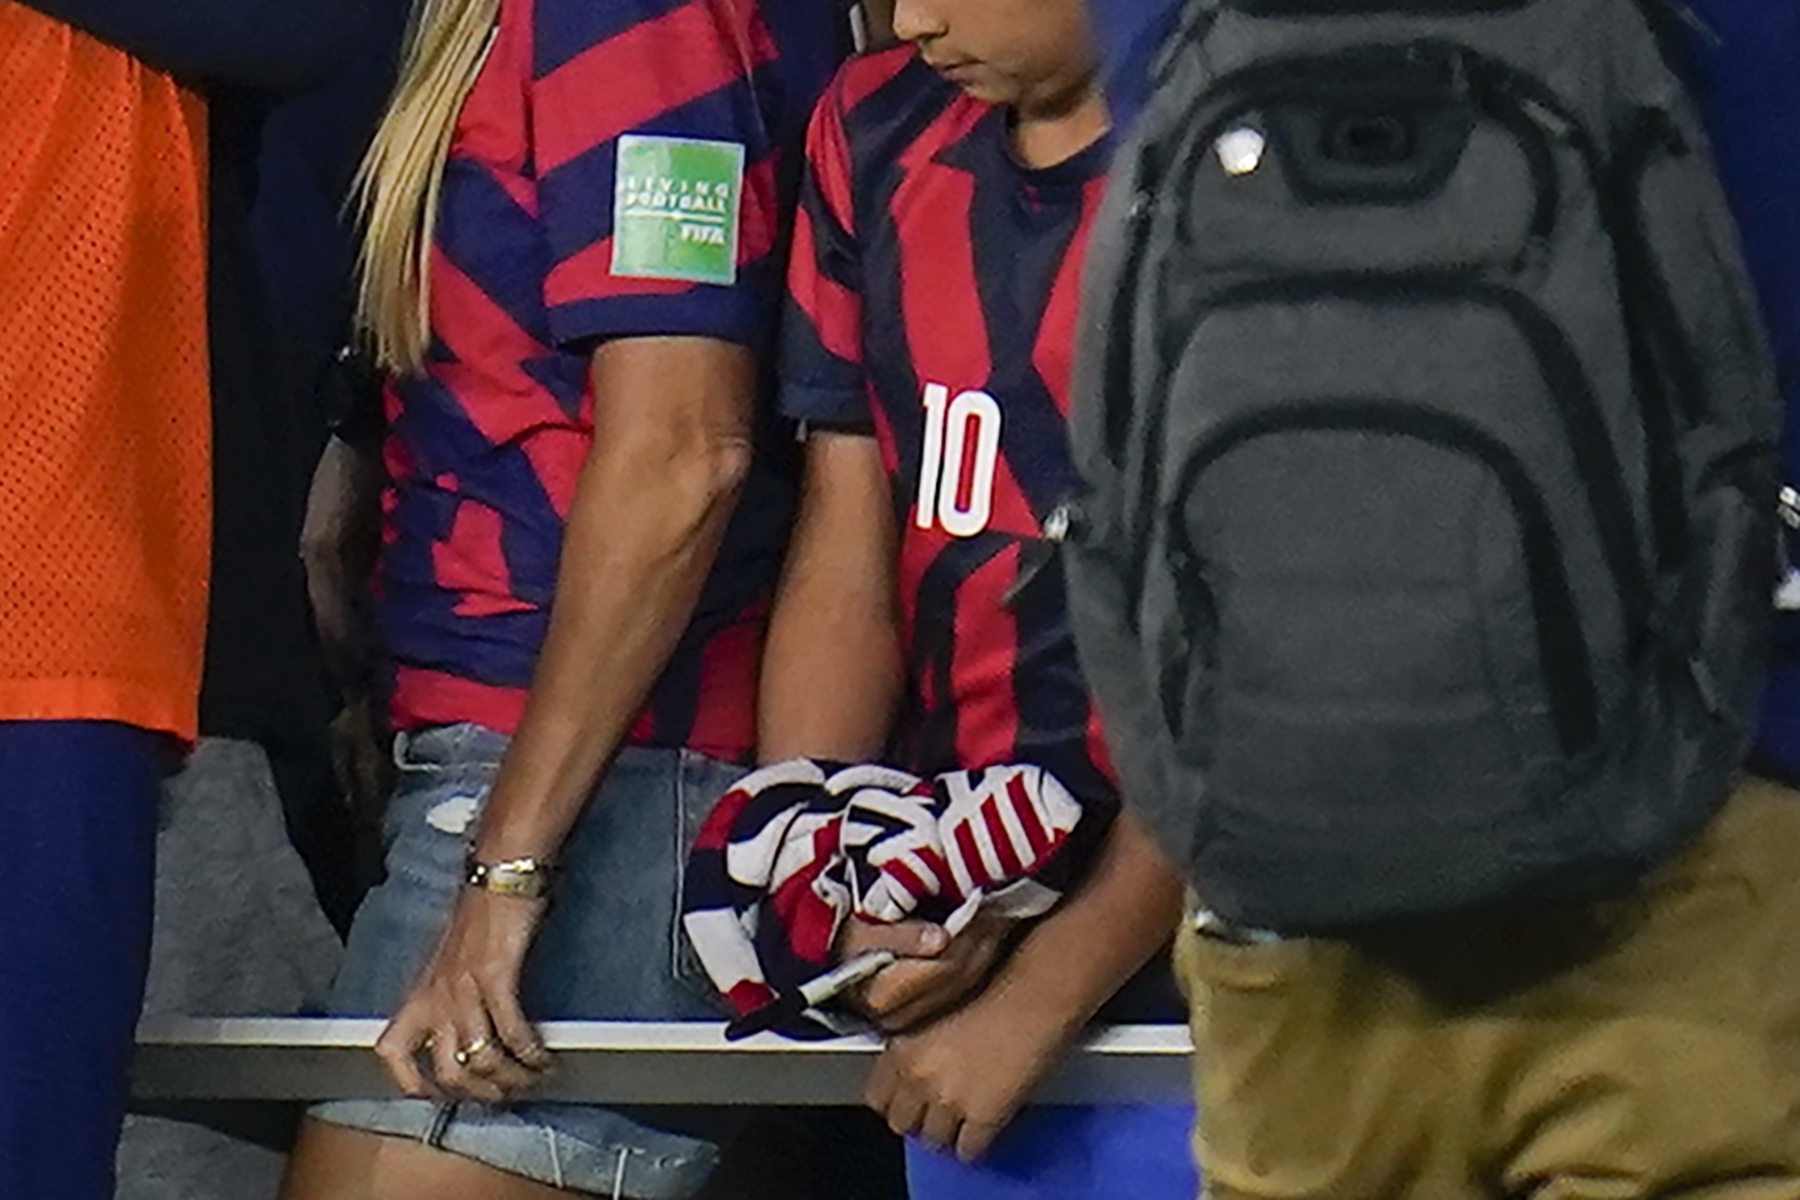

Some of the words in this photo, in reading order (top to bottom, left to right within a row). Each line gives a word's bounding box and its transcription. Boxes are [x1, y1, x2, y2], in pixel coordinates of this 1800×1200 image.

[626, 176, 730, 199] LIVING
[625, 193, 725, 214] FOOTBALL
[681, 224, 726, 245] FIFA
[916, 382, 1001, 538] 10
